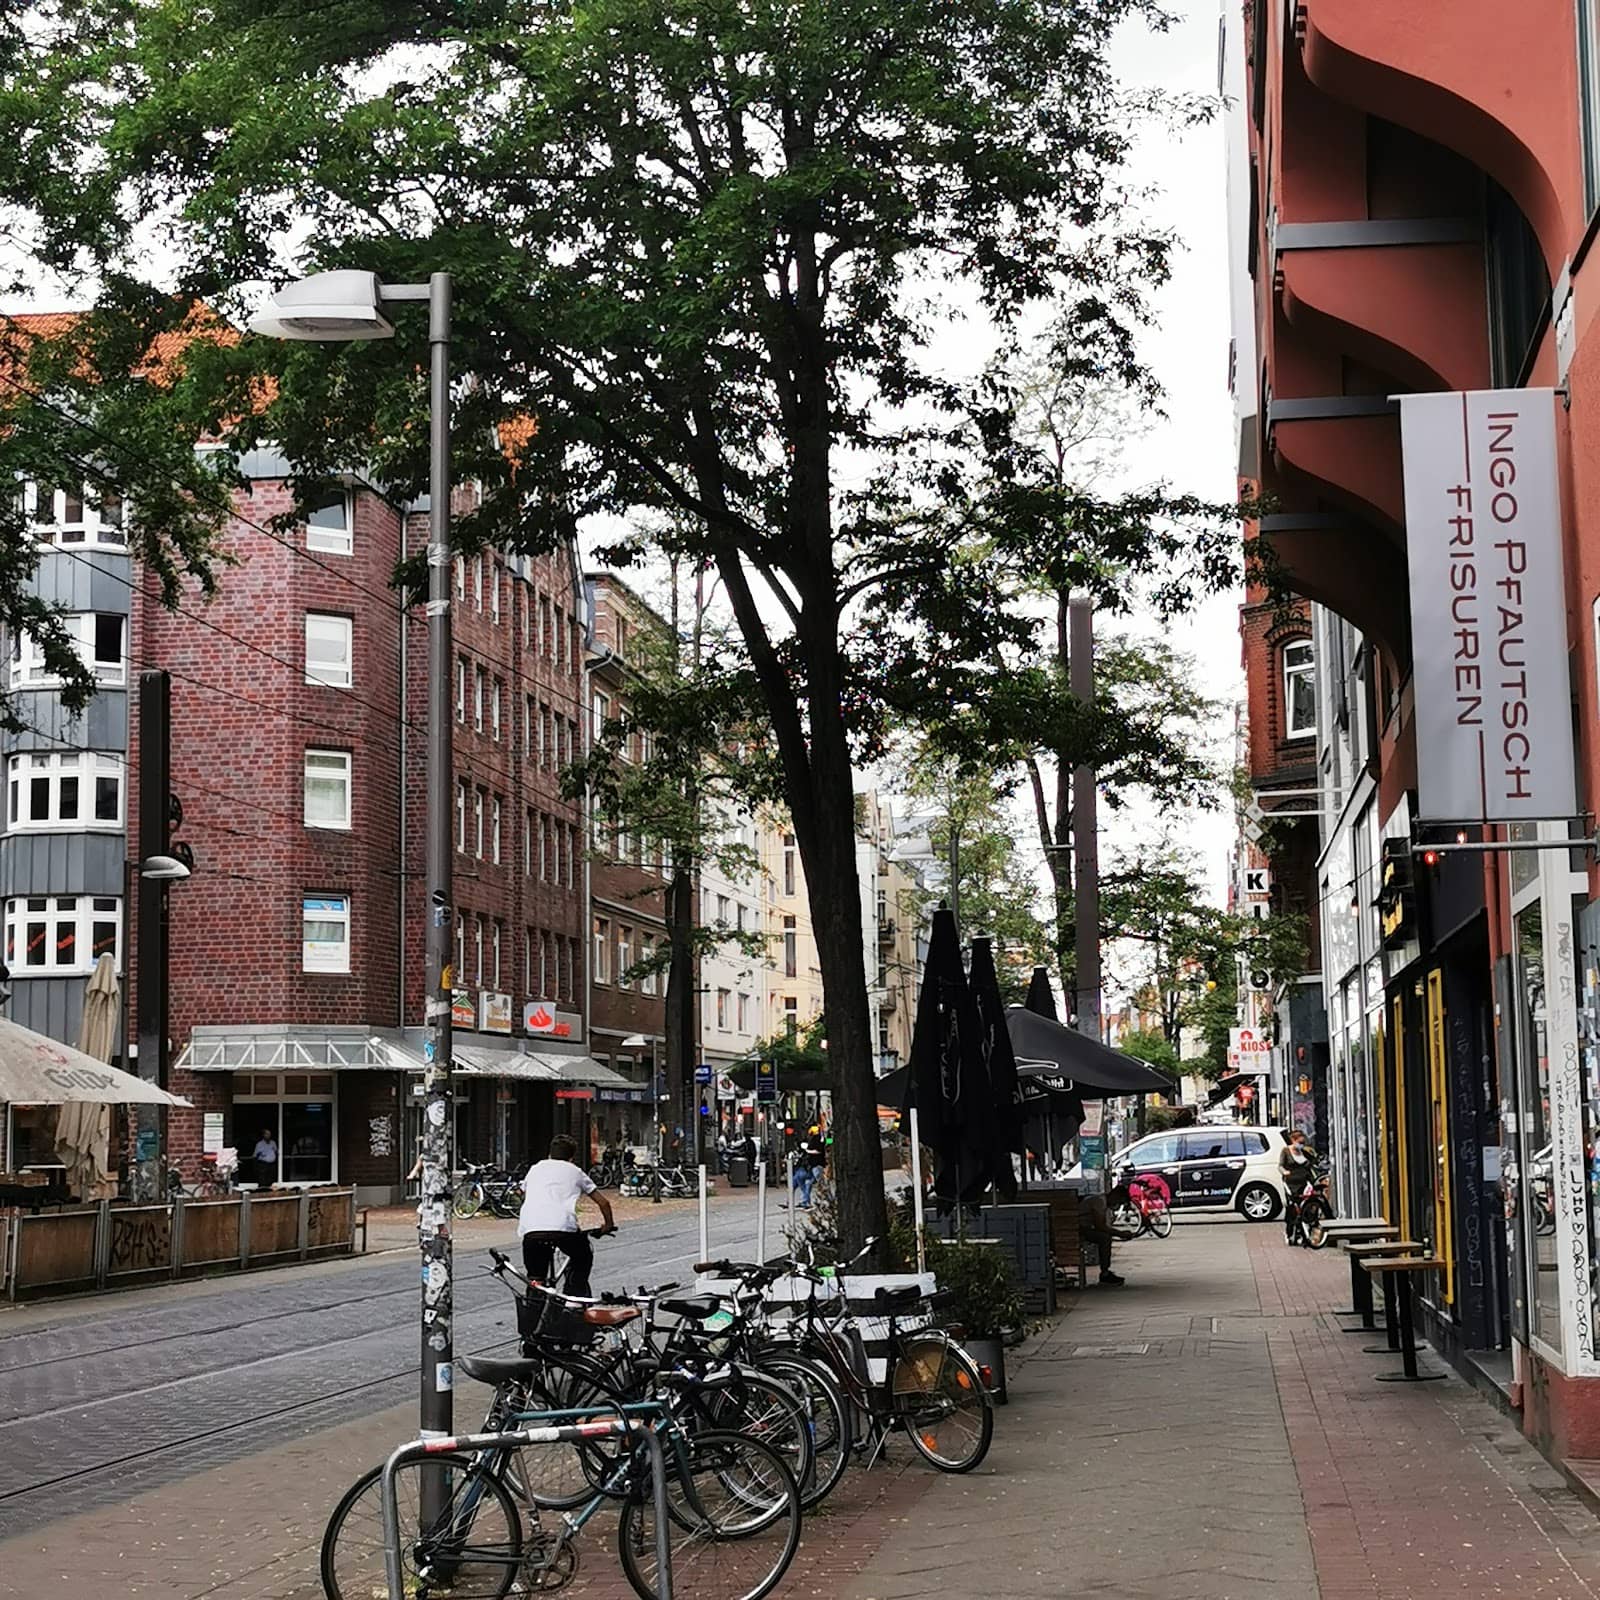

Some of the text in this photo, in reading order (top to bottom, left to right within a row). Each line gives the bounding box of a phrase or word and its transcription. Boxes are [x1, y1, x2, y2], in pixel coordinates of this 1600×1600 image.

[1446, 484, 1483, 726] FRISUREN
[1487, 413, 1532, 799] INGO PFAUTSCH
